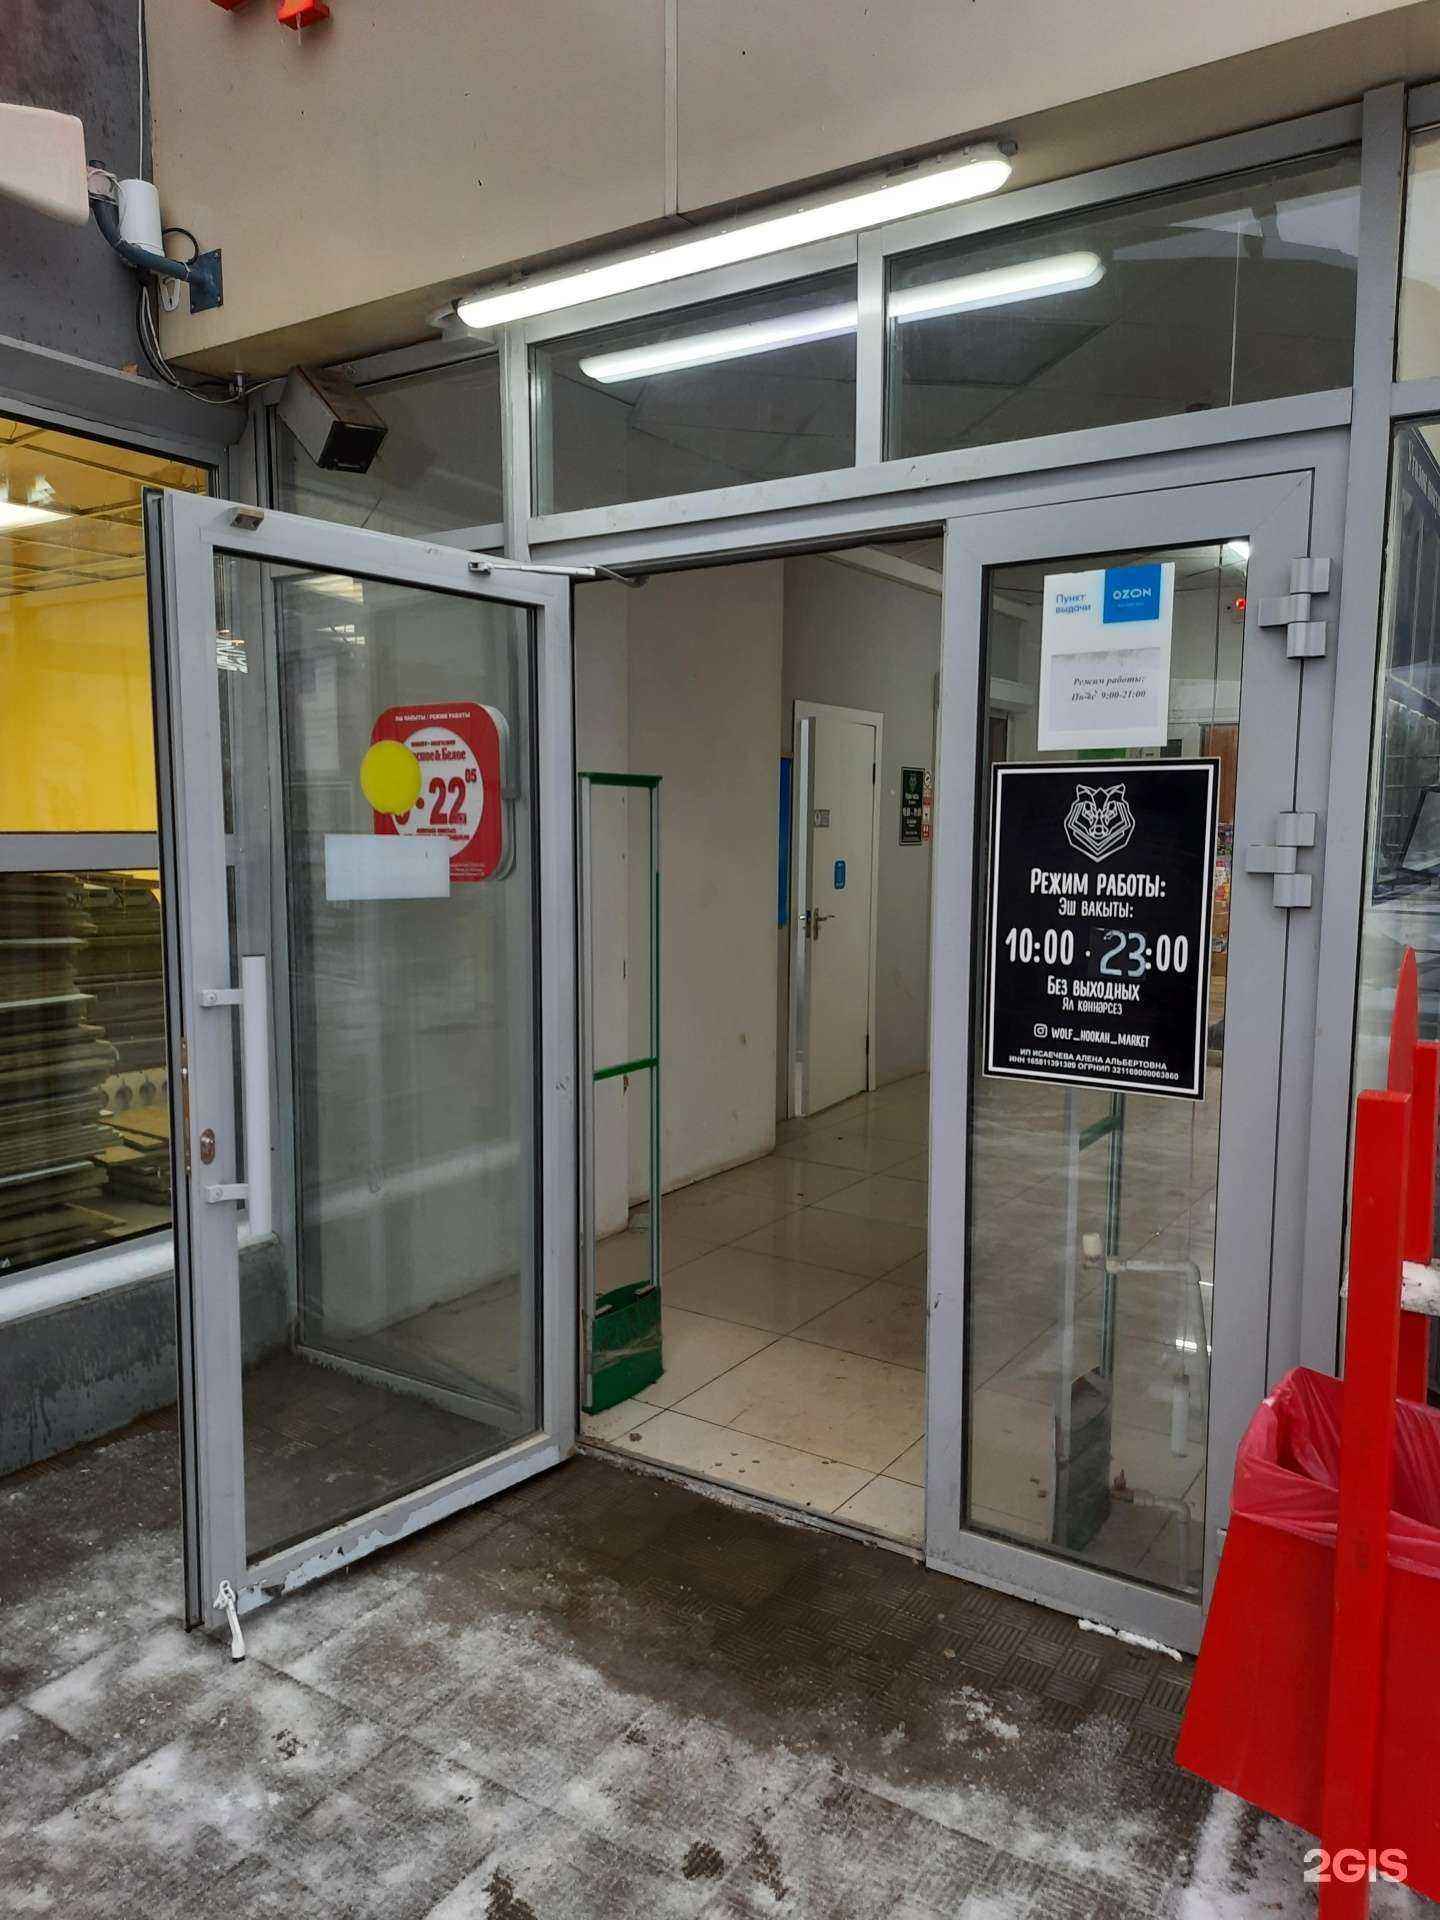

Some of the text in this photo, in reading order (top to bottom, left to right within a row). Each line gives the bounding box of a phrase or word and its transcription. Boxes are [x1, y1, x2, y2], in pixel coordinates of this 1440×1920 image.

[1056, 593, 1086, 605] Пункт
[1112, 587, 1152, 600] OZON
[1055, 604, 1091, 615] выдачи
[1096, 872, 1166, 898] РАБОТЫ:
[1081, 900, 1134, 918] ВАКЫТЫ:
[1005, 927, 1074, 965] 10:00
[1100, 929, 1189, 978] 23:00
[1072, 980, 1141, 1001] ВЫХОДНЫХ
[1051, 1026, 1150, 1048] WOLF_HOOKAH_MARKET
[1009, 1055, 1026, 1064] ИНН
[1077, 1062, 1111, 1073] ОГРНИП
[1020, 1048, 1168, 1071] ИП ИСАЕЧЕВА АЛЕНА АЛЬБЕРТОВНА
